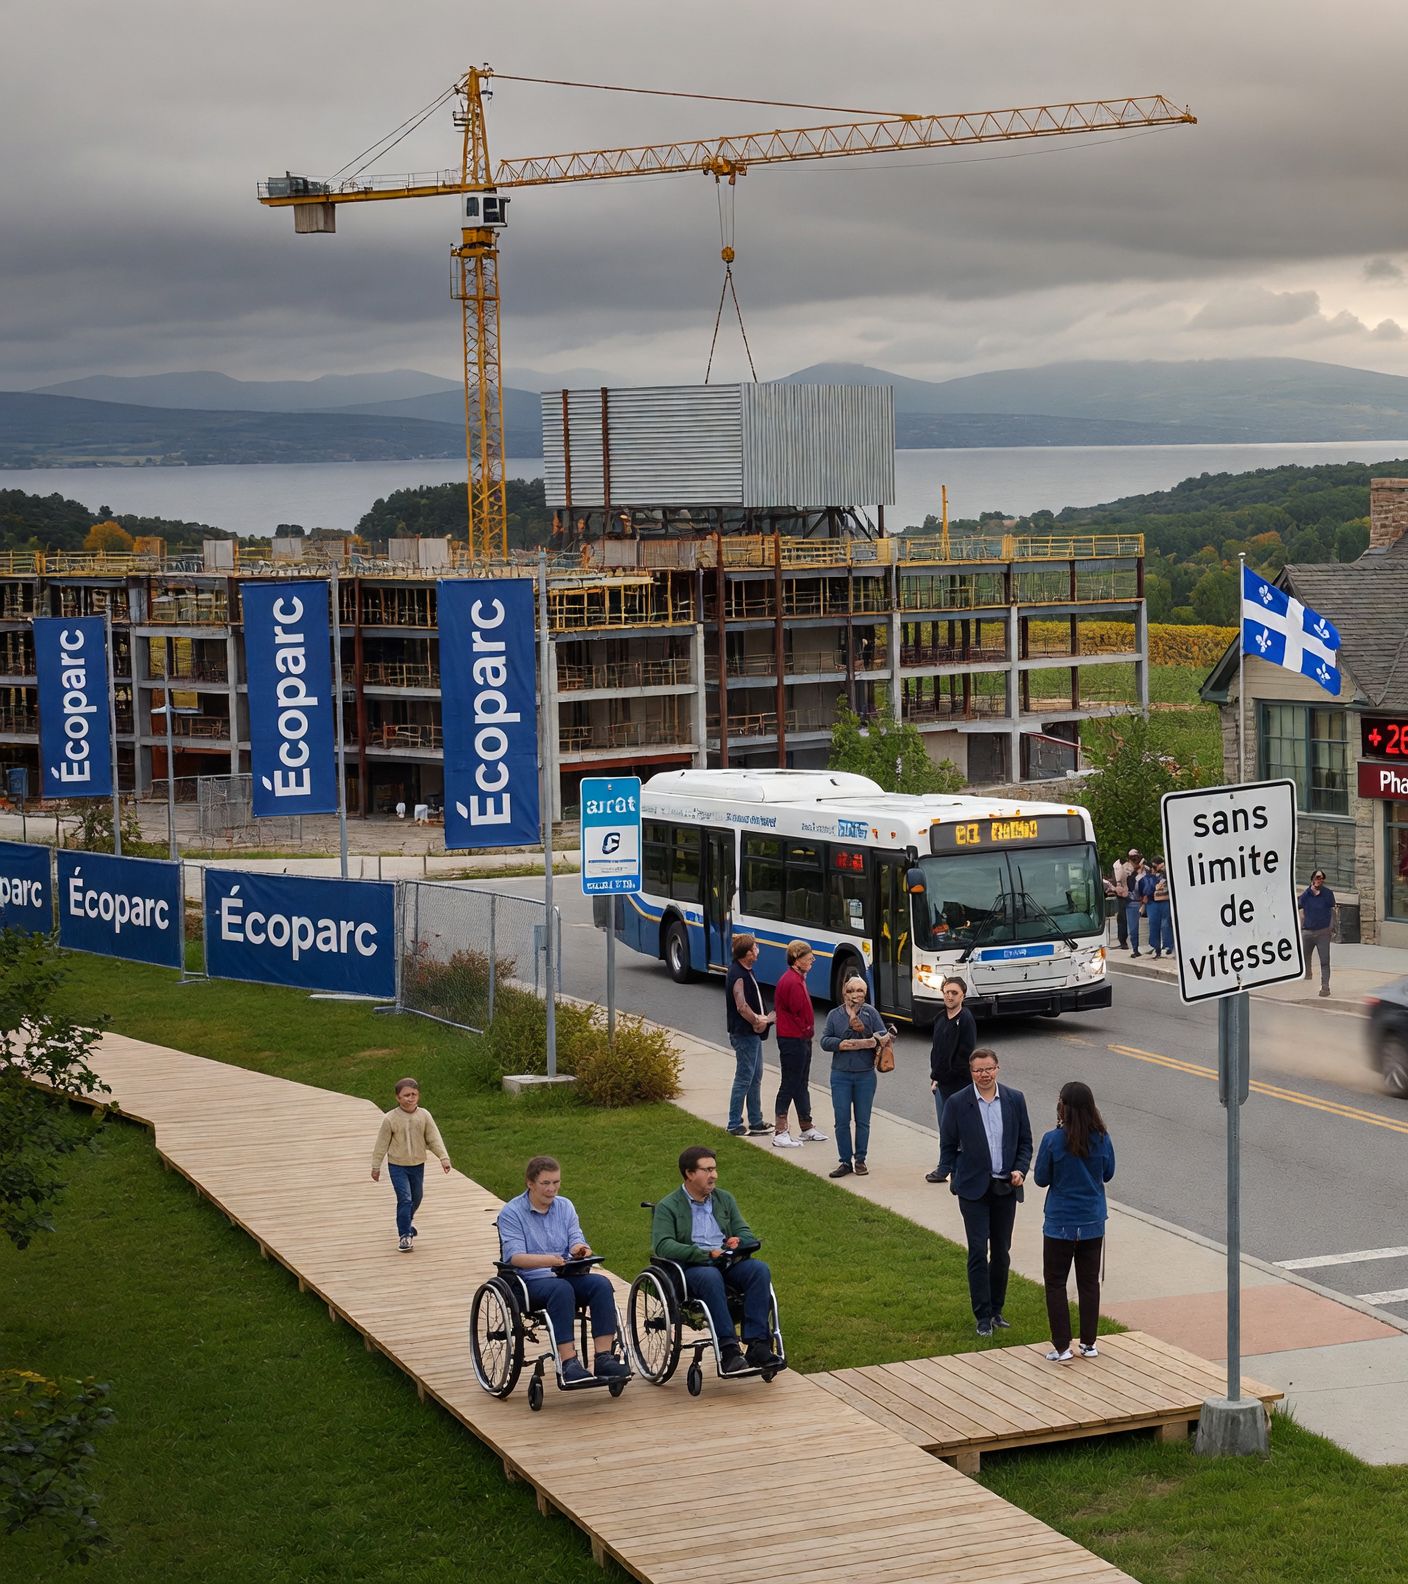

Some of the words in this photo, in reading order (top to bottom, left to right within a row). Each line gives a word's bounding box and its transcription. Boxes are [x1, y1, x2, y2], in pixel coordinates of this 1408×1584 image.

[51, 629, 97, 782] Écoparc
[261, 596, 318, 797] Écoparc
[456, 598, 521, 826] Écoparc
[1192, 803, 1269, 838] sans
[0, 876, 42, 908] parc
[1187, 844, 1279, 887] limite
[69, 866, 169, 933] Écoparc
[220, 885, 379, 961] Écoparc
[1220, 893, 1255, 928] de
[1189, 935, 1293, 980] vitesse
